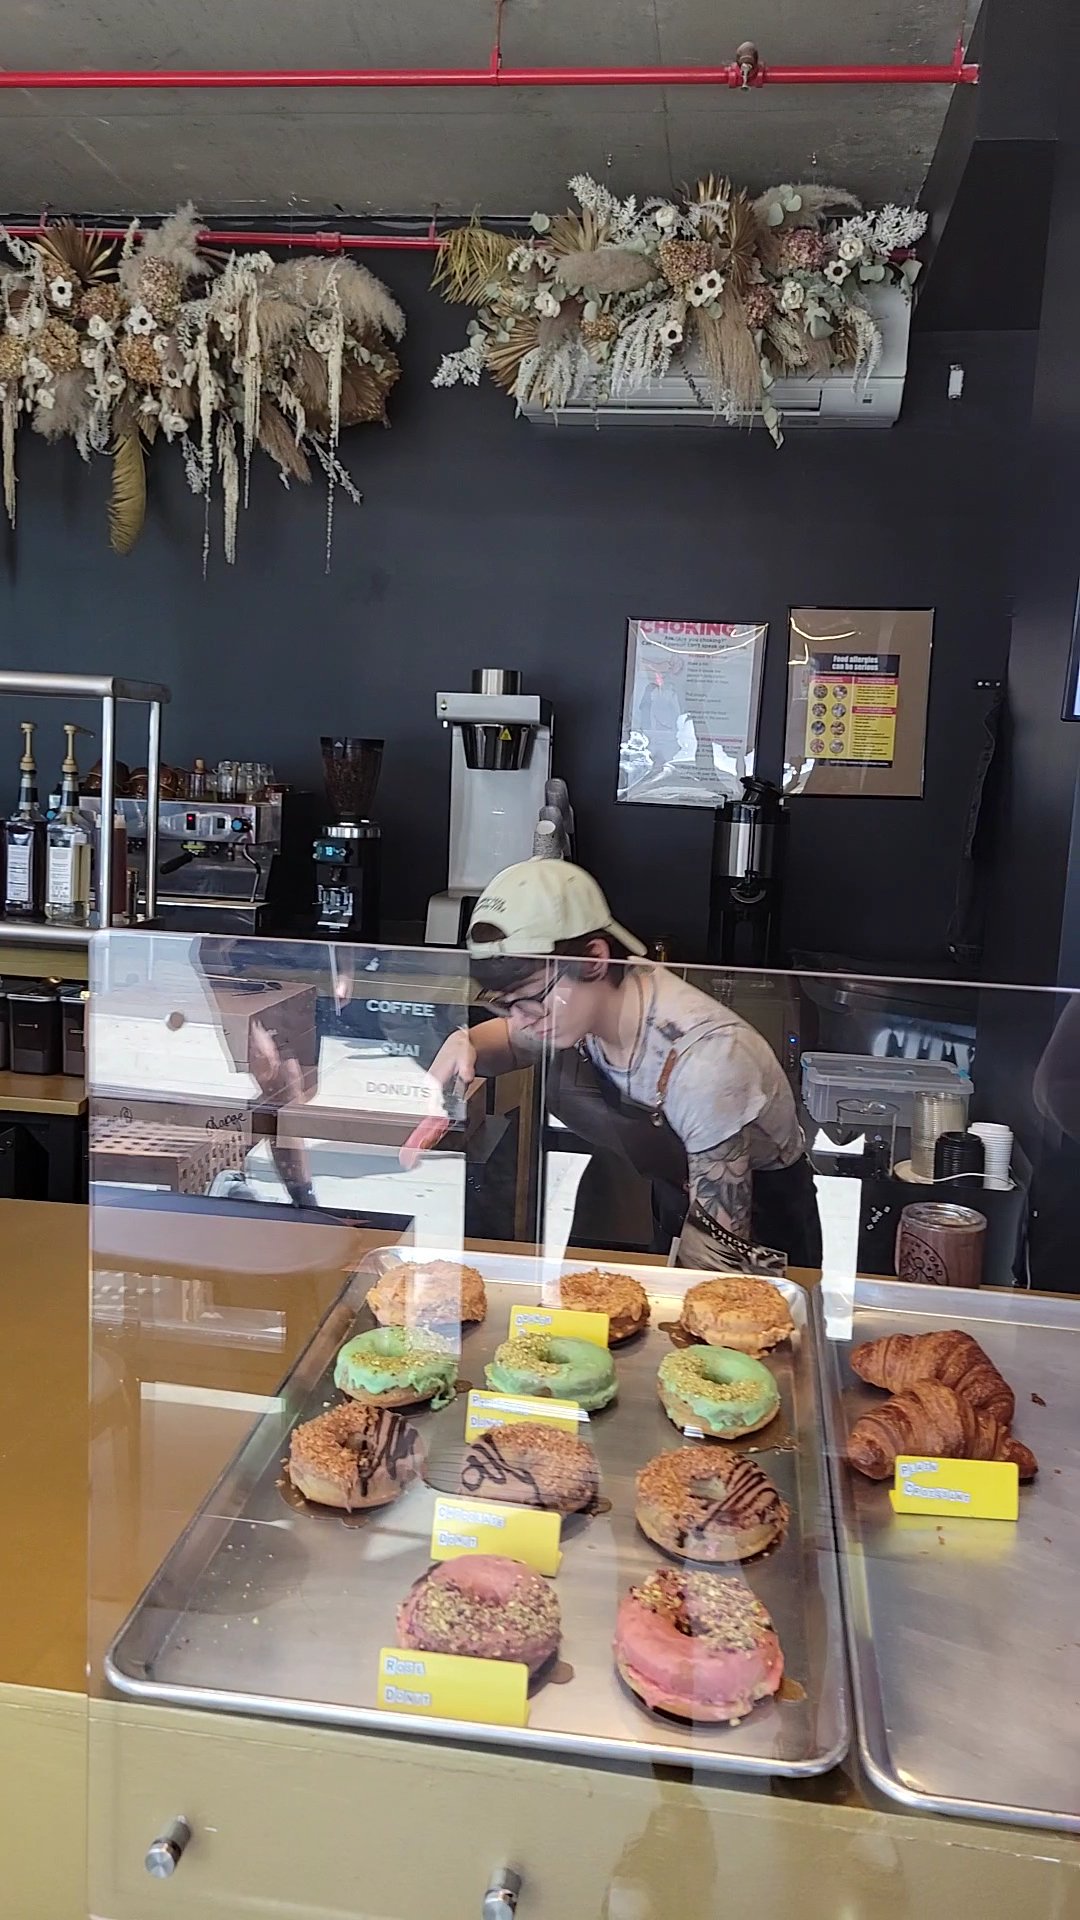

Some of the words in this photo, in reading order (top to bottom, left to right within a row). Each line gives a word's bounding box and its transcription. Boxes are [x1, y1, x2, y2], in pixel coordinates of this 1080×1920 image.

[640, 620, 737, 637] CHOKING
[833, 655, 849, 663] Food
[850, 656, 878, 664] allergies
[845, 663, 853, 671] be
[365, 999, 436, 1017] COFFEE
[381, 1042, 420, 1057] CHAI
[365, 1081, 431, 1098] DONUTS
[384, 1685, 431, 1706] DONUT
